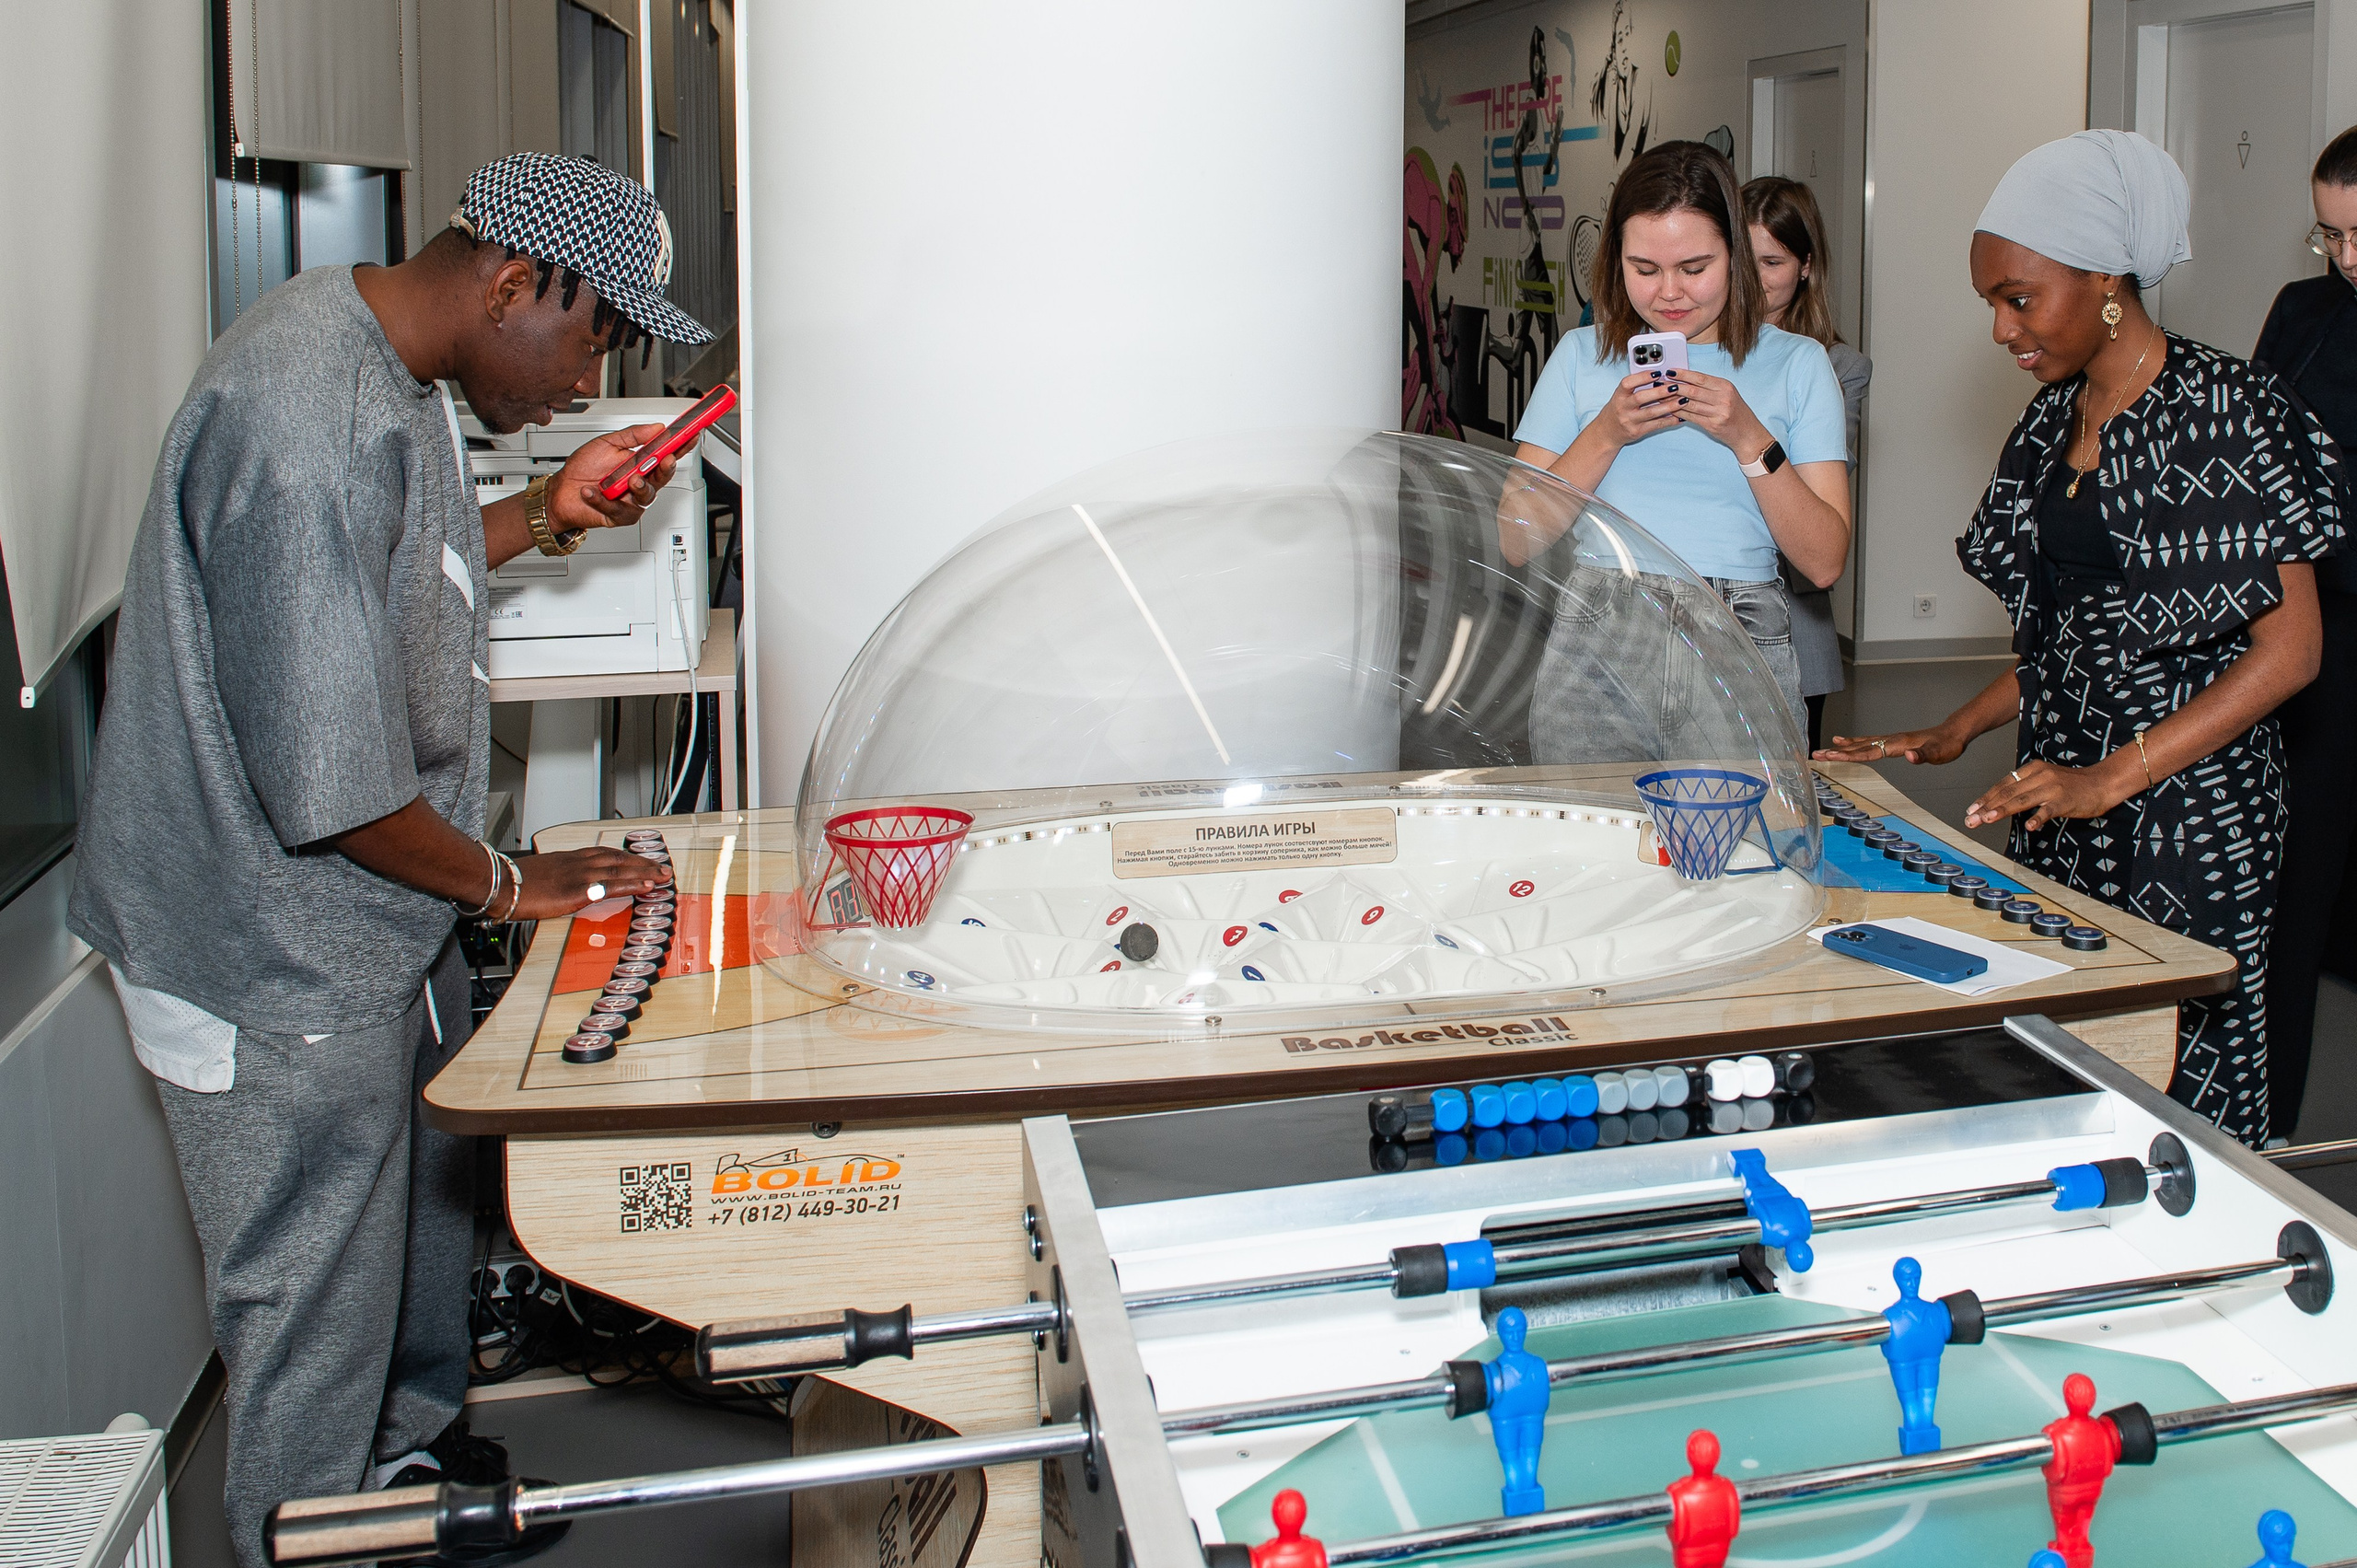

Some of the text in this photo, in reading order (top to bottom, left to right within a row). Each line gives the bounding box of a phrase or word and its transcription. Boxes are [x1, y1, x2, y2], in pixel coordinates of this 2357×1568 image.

[1483, 195, 1564, 230] NO
[1195, 821, 1316, 841] ПРАВИЛА ИГРЫ
[1124, 849, 1145, 857] Перед
[1237, 842, 1262, 851] Номера
[1149, 854, 1176, 863] кнопки,
[1177, 852, 1213, 861] старайтесь
[1271, 847, 1306, 855] соперника,
[1167, 857, 1219, 868] Одновременно
[1281, 1016, 1571, 1053] Basketball
[1488, 1031, 1580, 1047] Classic
[783, 1153, 792, 1162] 1
[711, 1161, 902, 1194] BOLID
[711, 1183, 902, 1204] WWW.BOLID-TEAM.RU
[708, 1194, 900, 1226] +7 (812) 449-30-21
